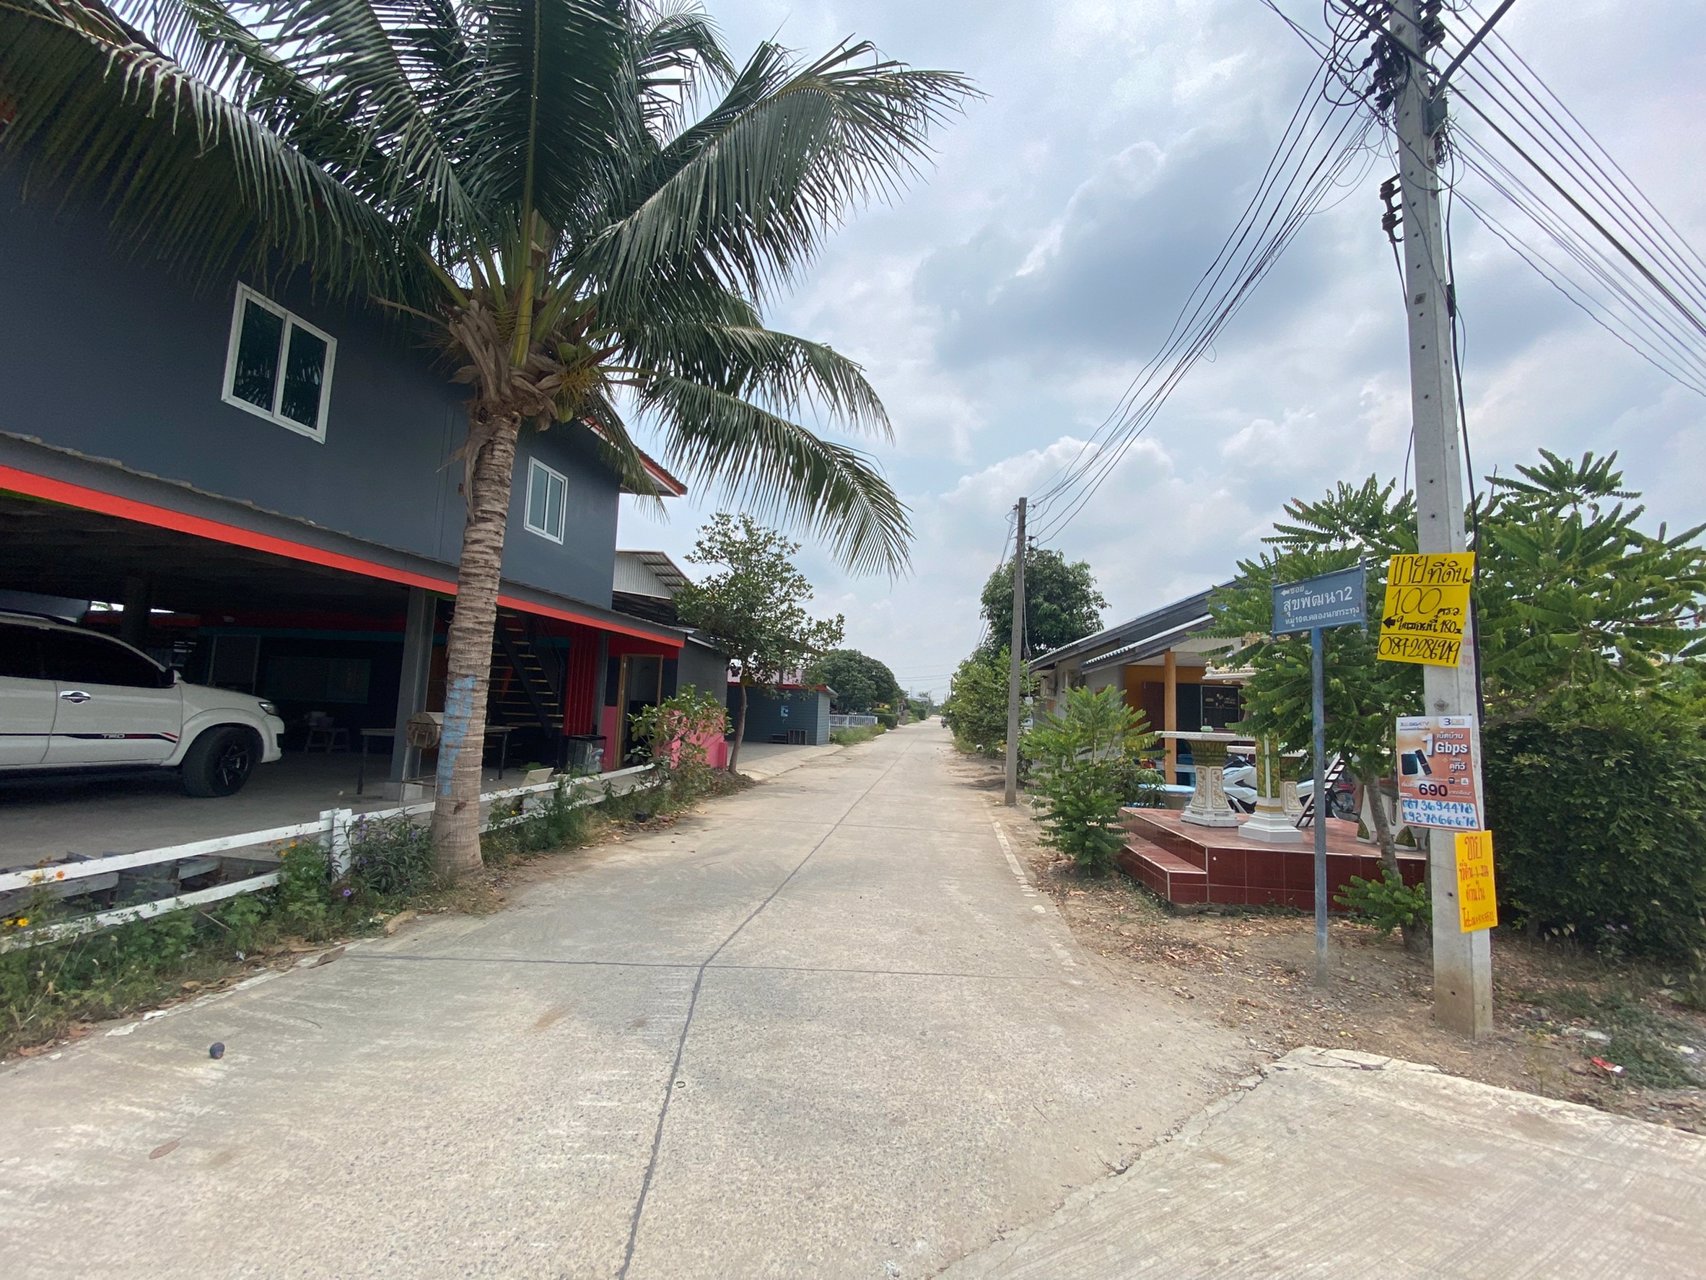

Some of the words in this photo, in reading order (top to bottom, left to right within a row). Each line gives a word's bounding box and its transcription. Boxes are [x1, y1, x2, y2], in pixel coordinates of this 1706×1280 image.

[1290, 585, 1305, 595] ซอย
[1391, 587, 1442, 615] 100
[1435, 741, 1468, 755] Gbps
[1418, 783, 1448, 797] 690
